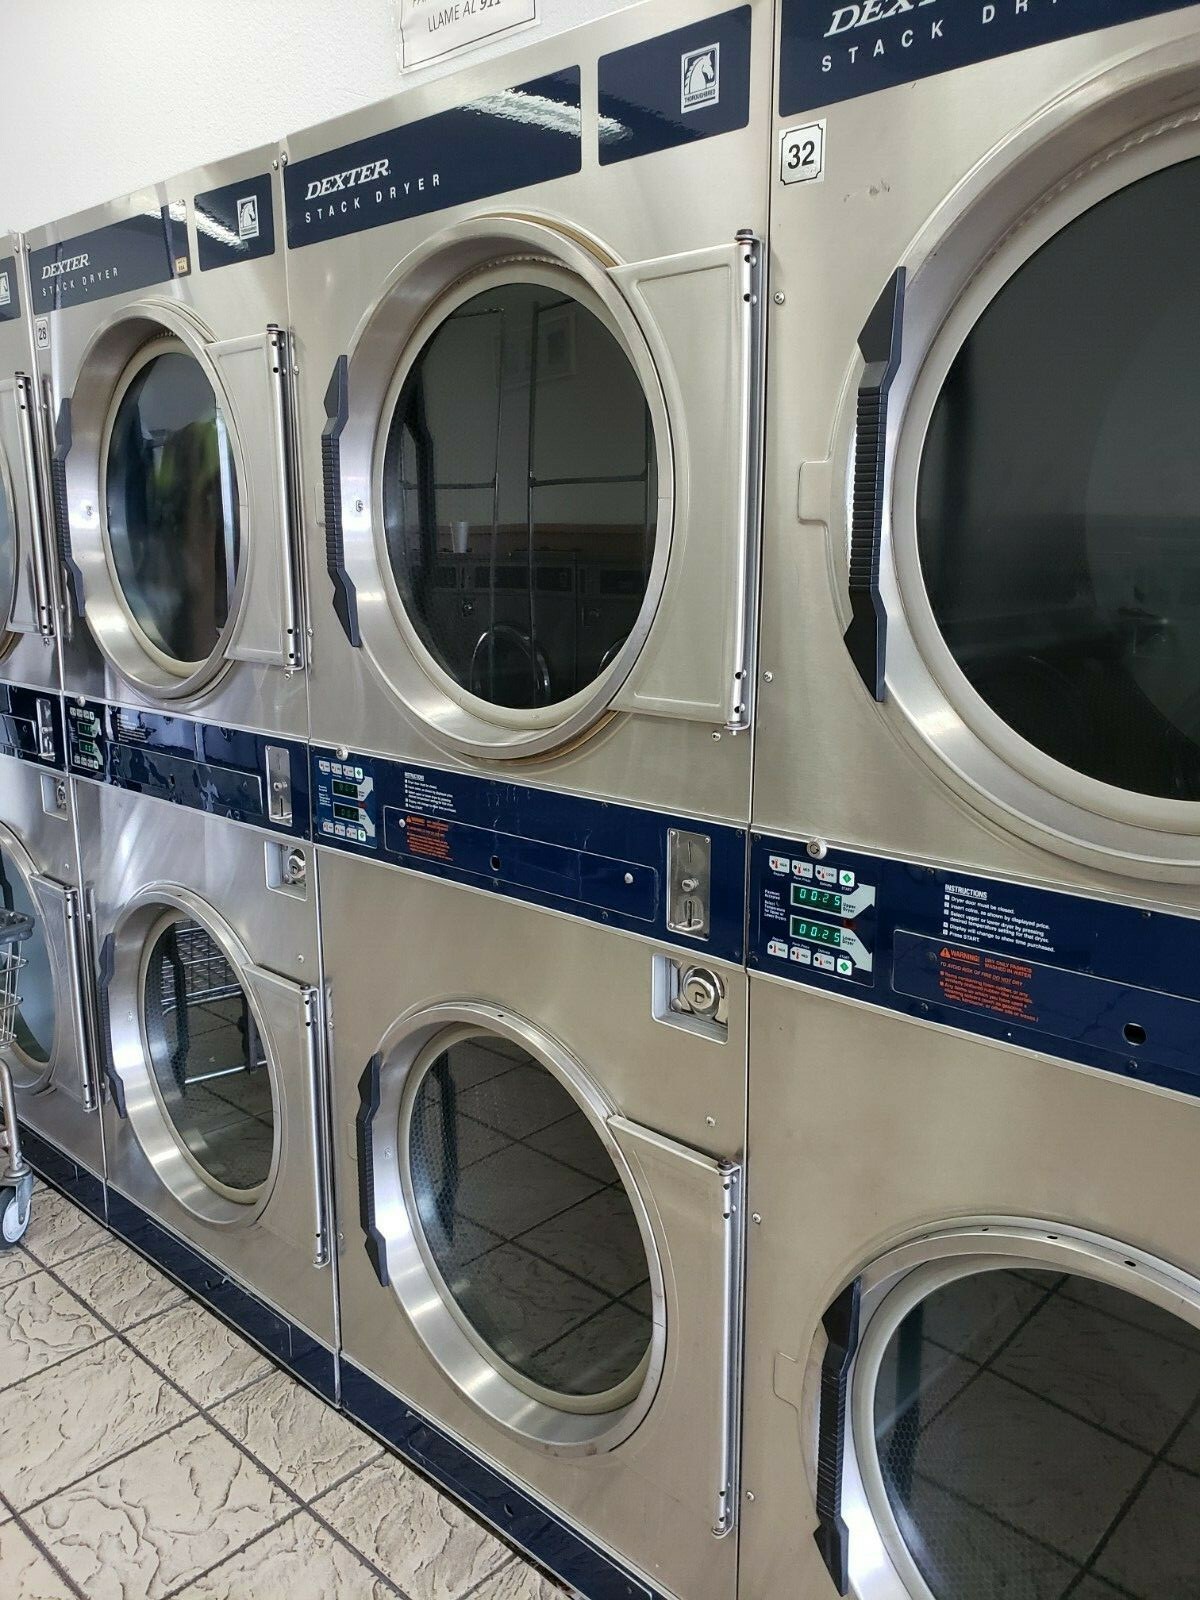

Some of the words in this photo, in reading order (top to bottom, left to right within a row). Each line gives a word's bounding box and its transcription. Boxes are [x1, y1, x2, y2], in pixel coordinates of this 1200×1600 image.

[427, 3, 459, 32] LLAME
[462, 0, 476, 17] AL
[821, 20, 943, 72] STACK
[787, 140, 815, 169] 32
[304, 158, 389, 200] DEXTER
[305, 198, 360, 223] STACK
[376, 174, 440, 203] DRYER
[41, 253, 89, 280] DEXTER
[42, 280, 75, 297] STACK
[82, 267, 118, 286] DRYER
[945, 884, 988, 900] INSTRUCTIONS
